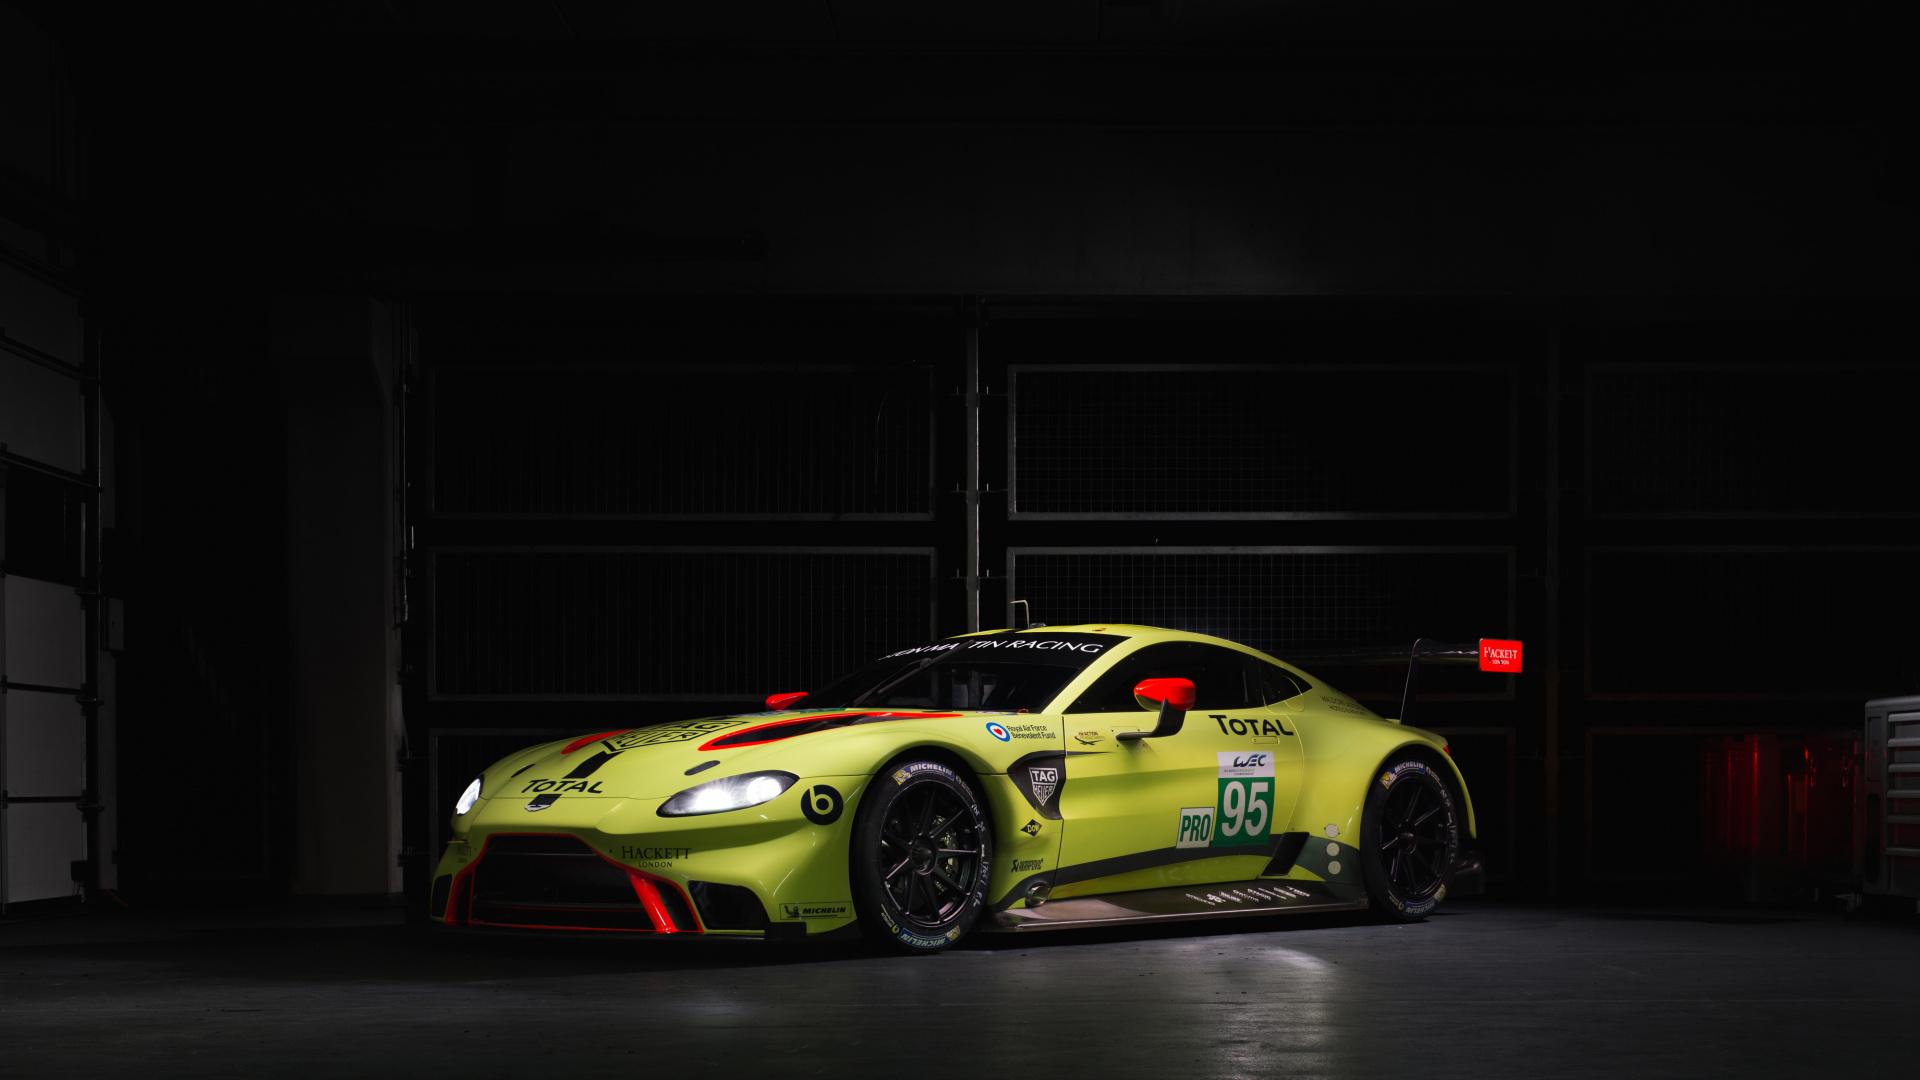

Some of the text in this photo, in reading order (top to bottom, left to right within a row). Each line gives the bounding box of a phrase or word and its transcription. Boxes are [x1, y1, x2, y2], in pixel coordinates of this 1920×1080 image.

[921, 641, 1008, 653] MATIN
[1008, 640, 1104, 653] RACING
[1483, 646, 1518, 660] HACKETT
[1029, 724, 1048, 732] Force
[1208, 714, 1295, 737] TOTAL
[1039, 731, 1057, 739] Fund
[1232, 753, 1268, 768] WEC
[1394, 761, 1424, 774] MICHELIN
[910, 763, 953, 776] MICHELIN
[1031, 770, 1056, 783] TAG
[521, 778, 604, 794] TOTAL
[1032, 784, 1055, 803] HEUER
[1221, 780, 1269, 837] 95
[1179, 813, 1211, 843] PRO
[621, 845, 692, 861] HACKETT
[802, 906, 847, 915] MICHELIN
[1405, 901, 1435, 915] MICHELIN
[900, 931, 946, 948] MICHELIN
